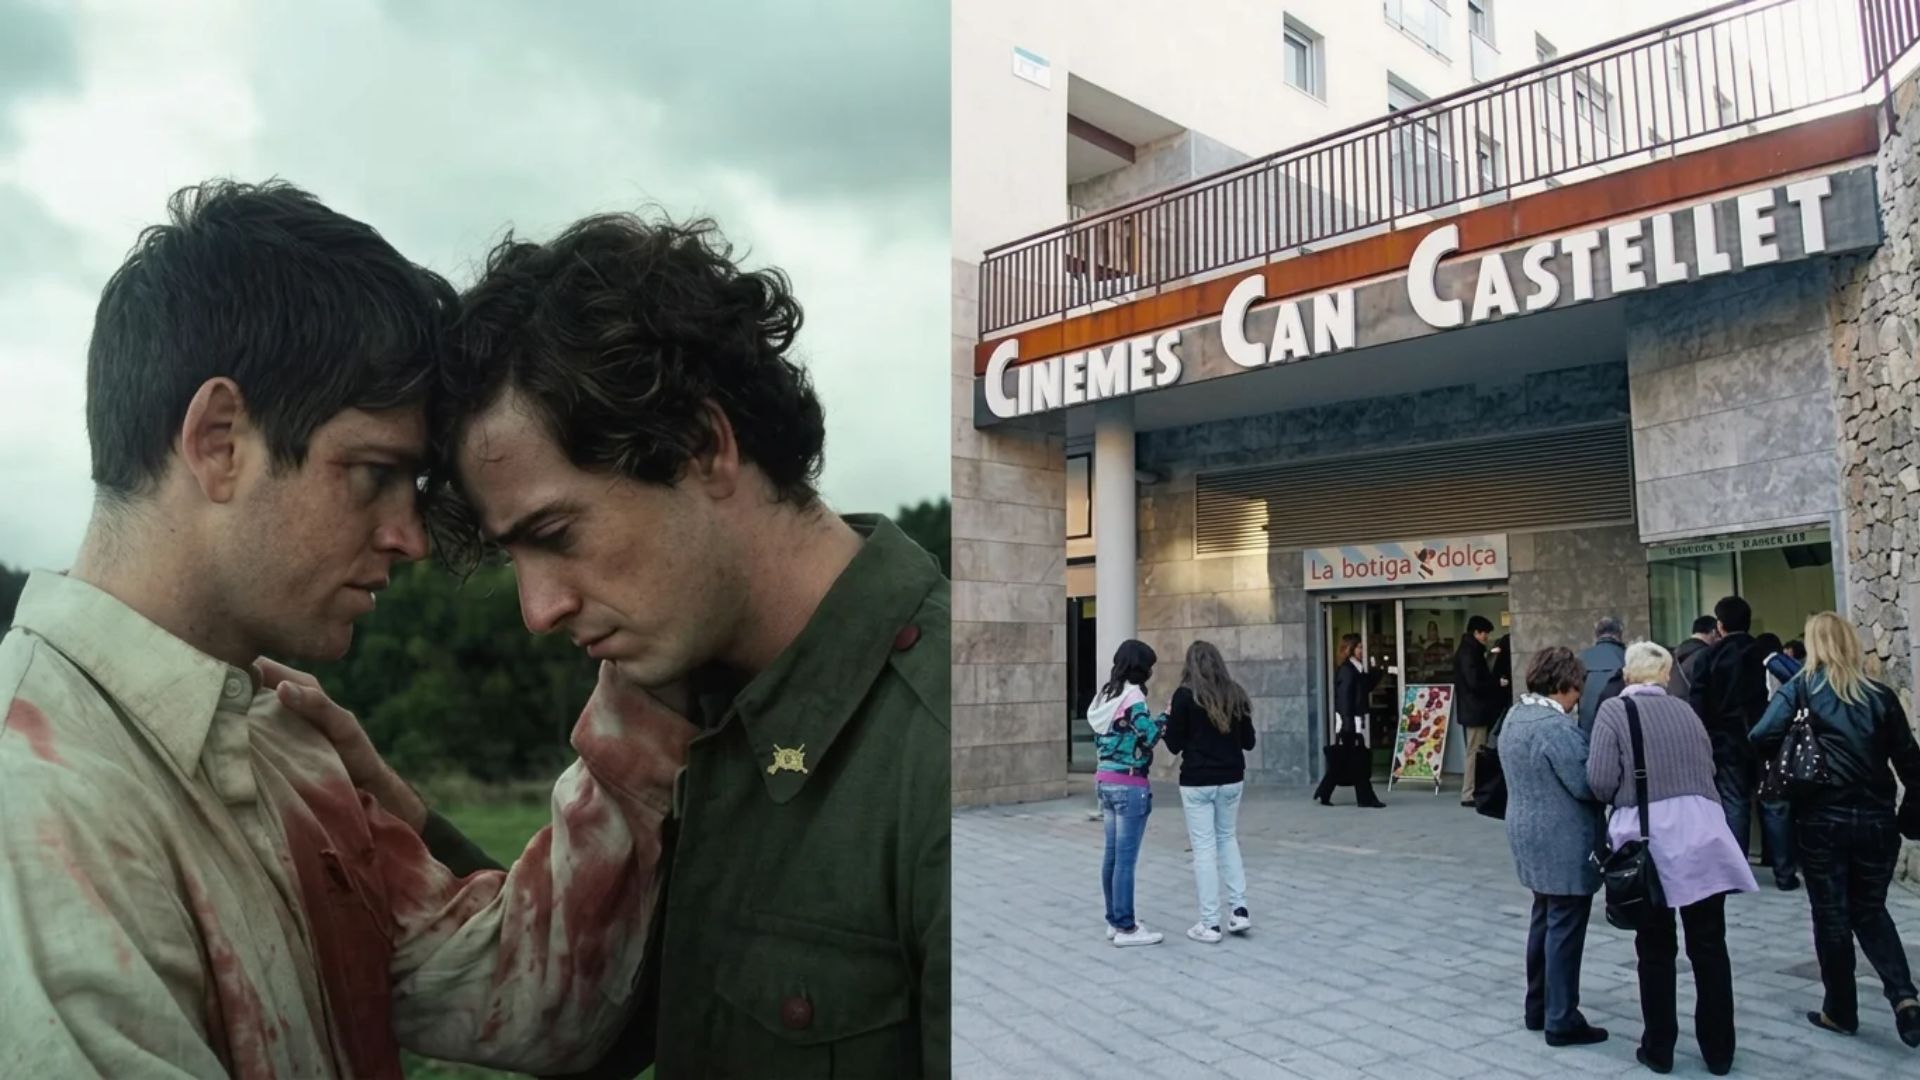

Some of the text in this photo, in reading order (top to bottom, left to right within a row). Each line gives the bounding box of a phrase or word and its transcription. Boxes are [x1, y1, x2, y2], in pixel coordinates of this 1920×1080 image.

[985, 176, 1831, 418] CINEMES CAN CASTELLET
[1311, 543, 1497, 581] La botiga dolça
